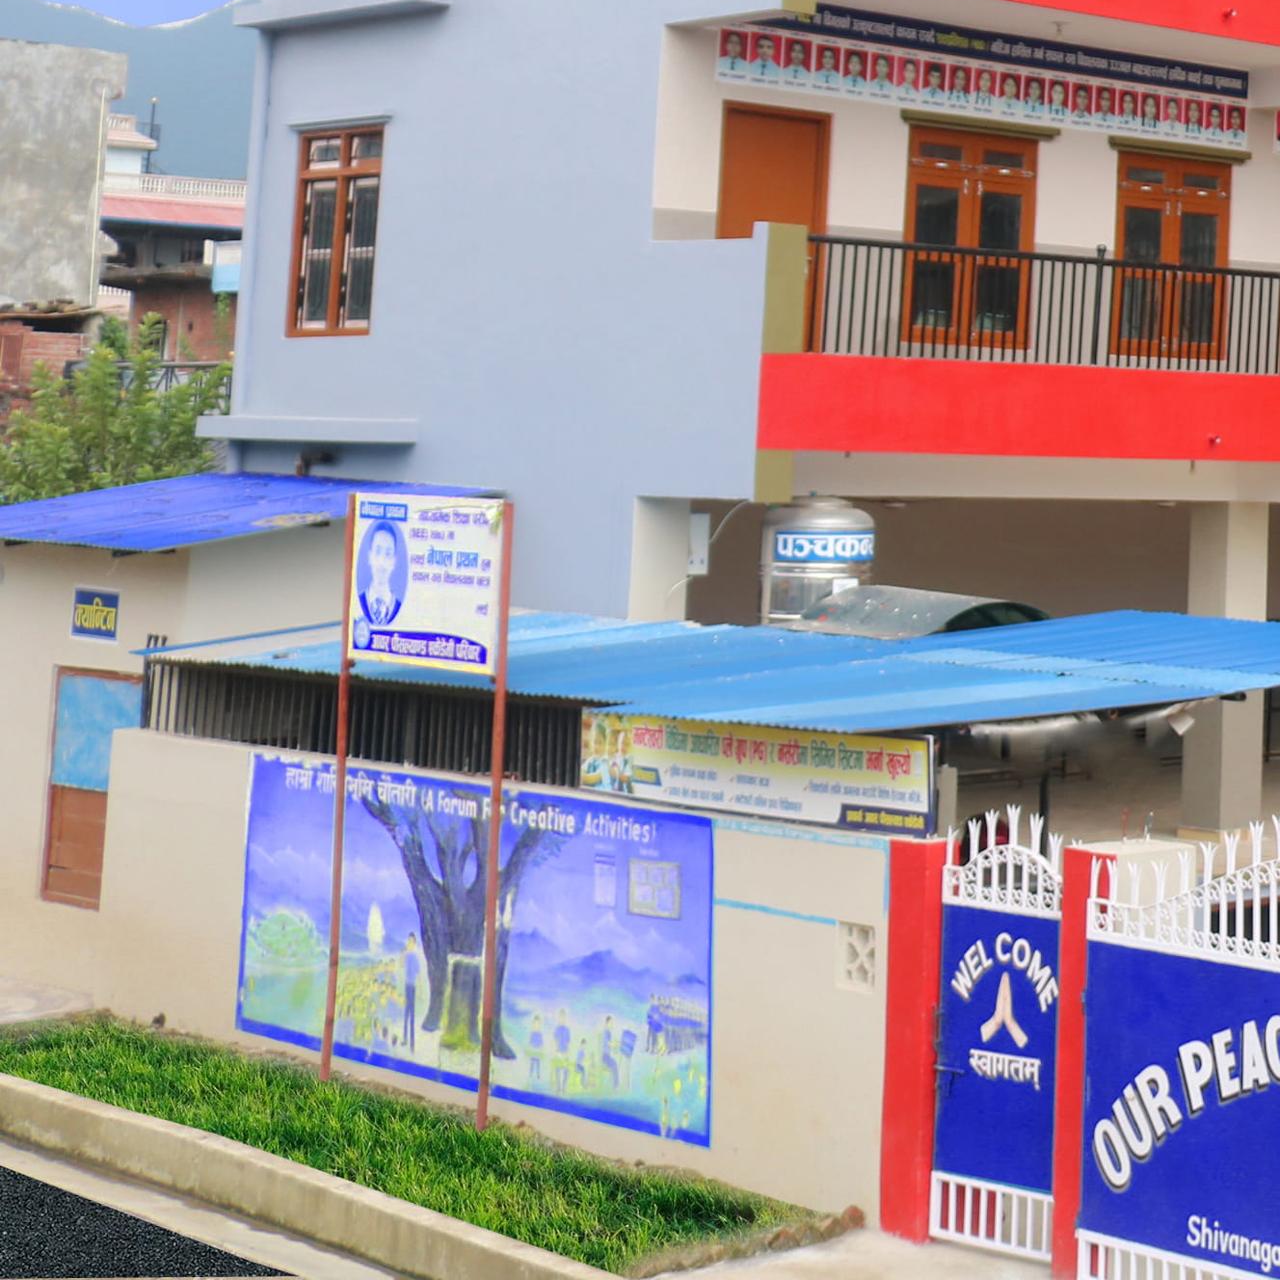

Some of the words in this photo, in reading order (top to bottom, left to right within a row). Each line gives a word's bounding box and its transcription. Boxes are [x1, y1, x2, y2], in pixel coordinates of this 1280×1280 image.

[438, 790, 477, 818] Forum
[510, 802, 574, 833] Creative
[1091, 1062, 1184, 1194] OUR
